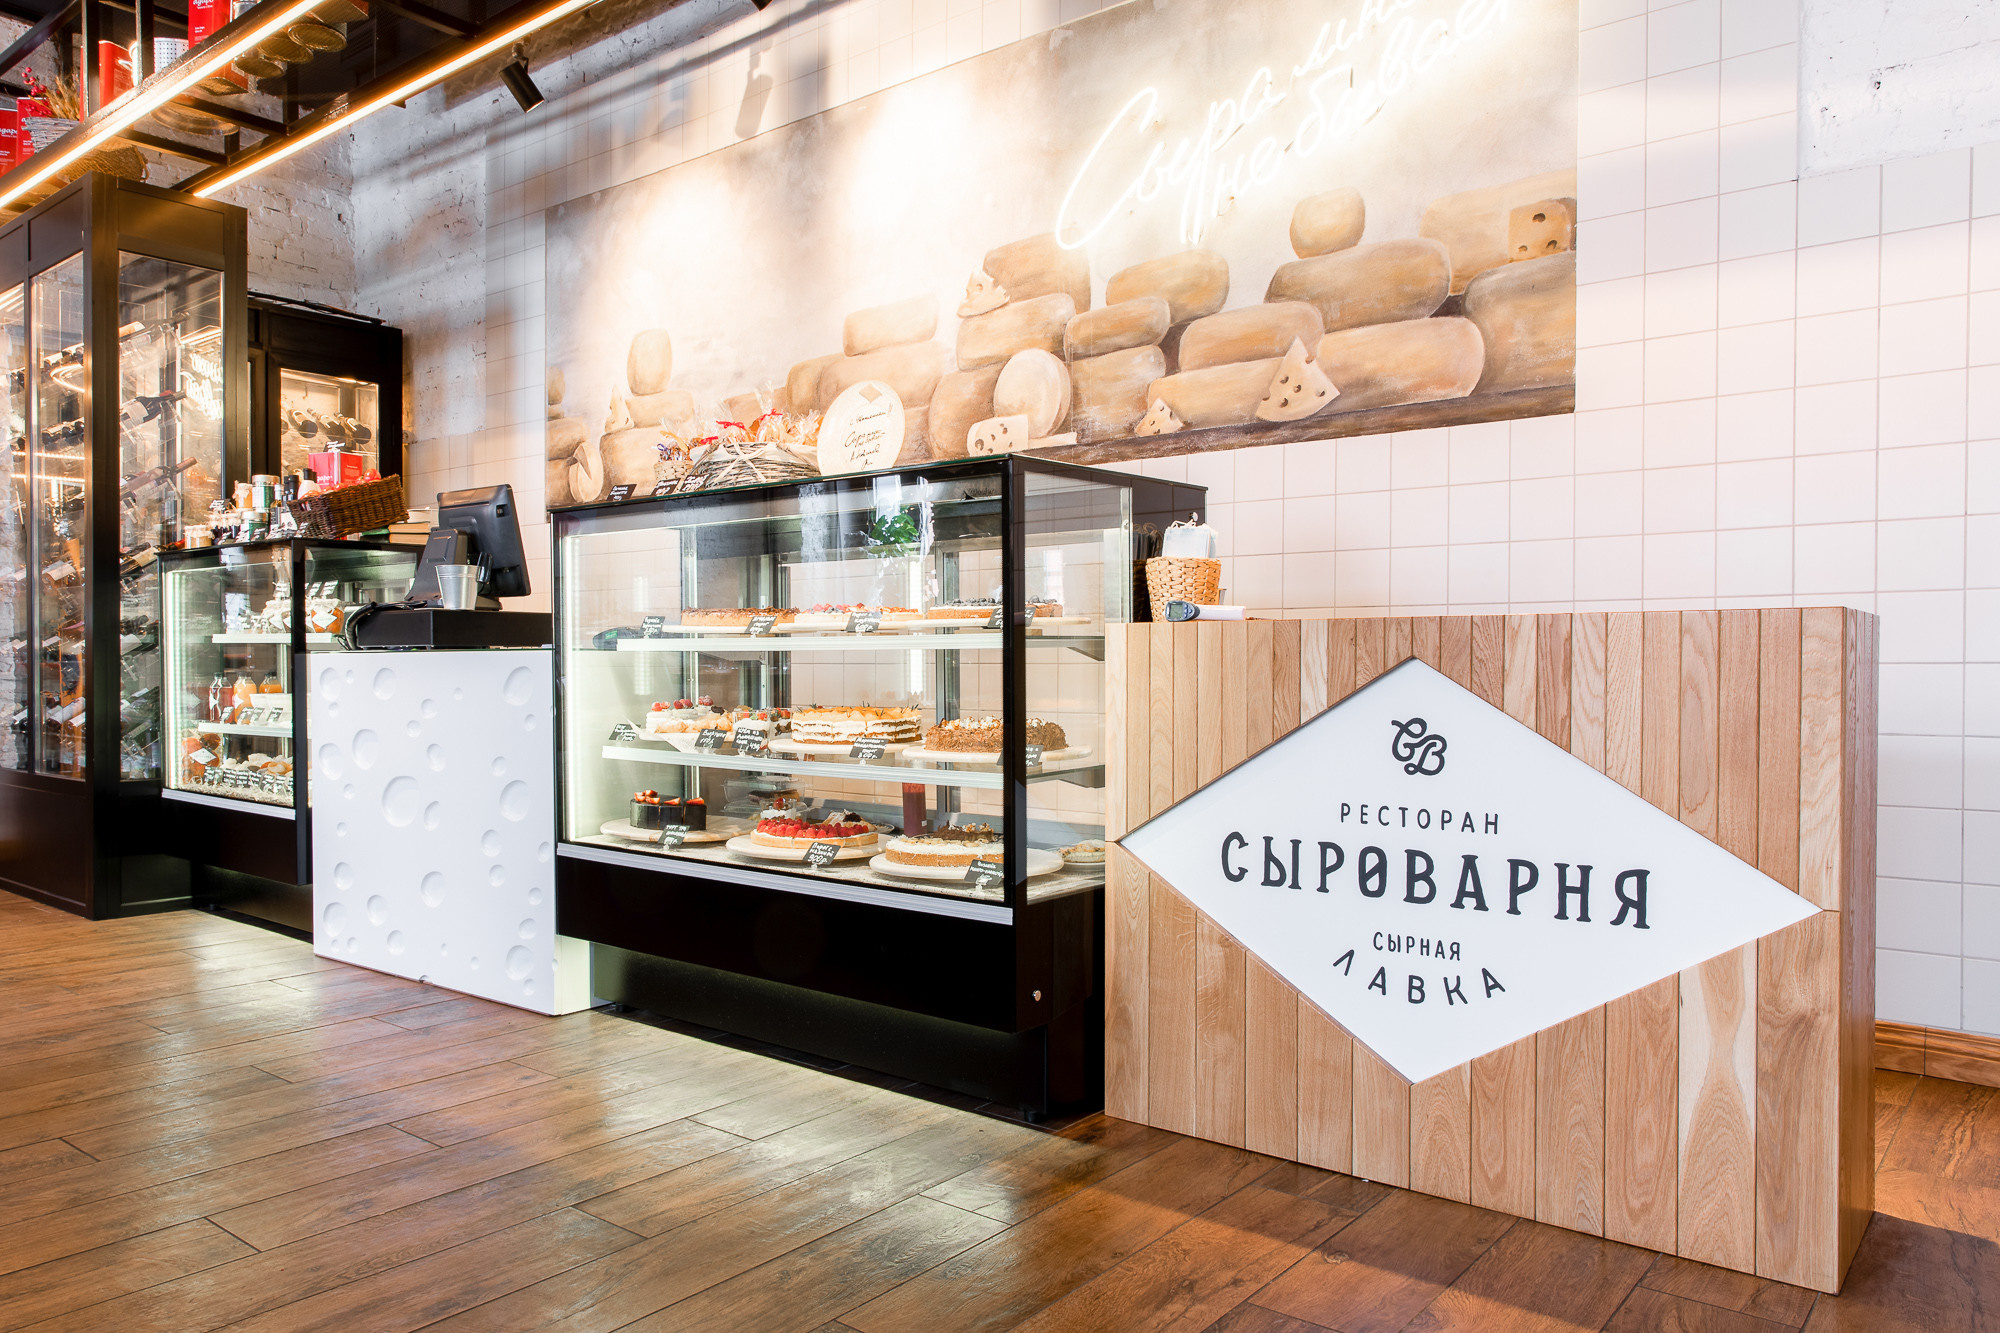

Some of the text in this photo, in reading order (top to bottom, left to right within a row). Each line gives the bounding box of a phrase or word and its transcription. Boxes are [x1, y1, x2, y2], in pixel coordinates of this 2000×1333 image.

[1340, 802, 1499, 835] РЕСТОРАН
[1221, 831, 1651, 930] СЫРОВАРНЯ
[1372, 931, 1461, 962] СЫРНАЯ
[1332, 949, 1506, 1006] ЛАВКА
